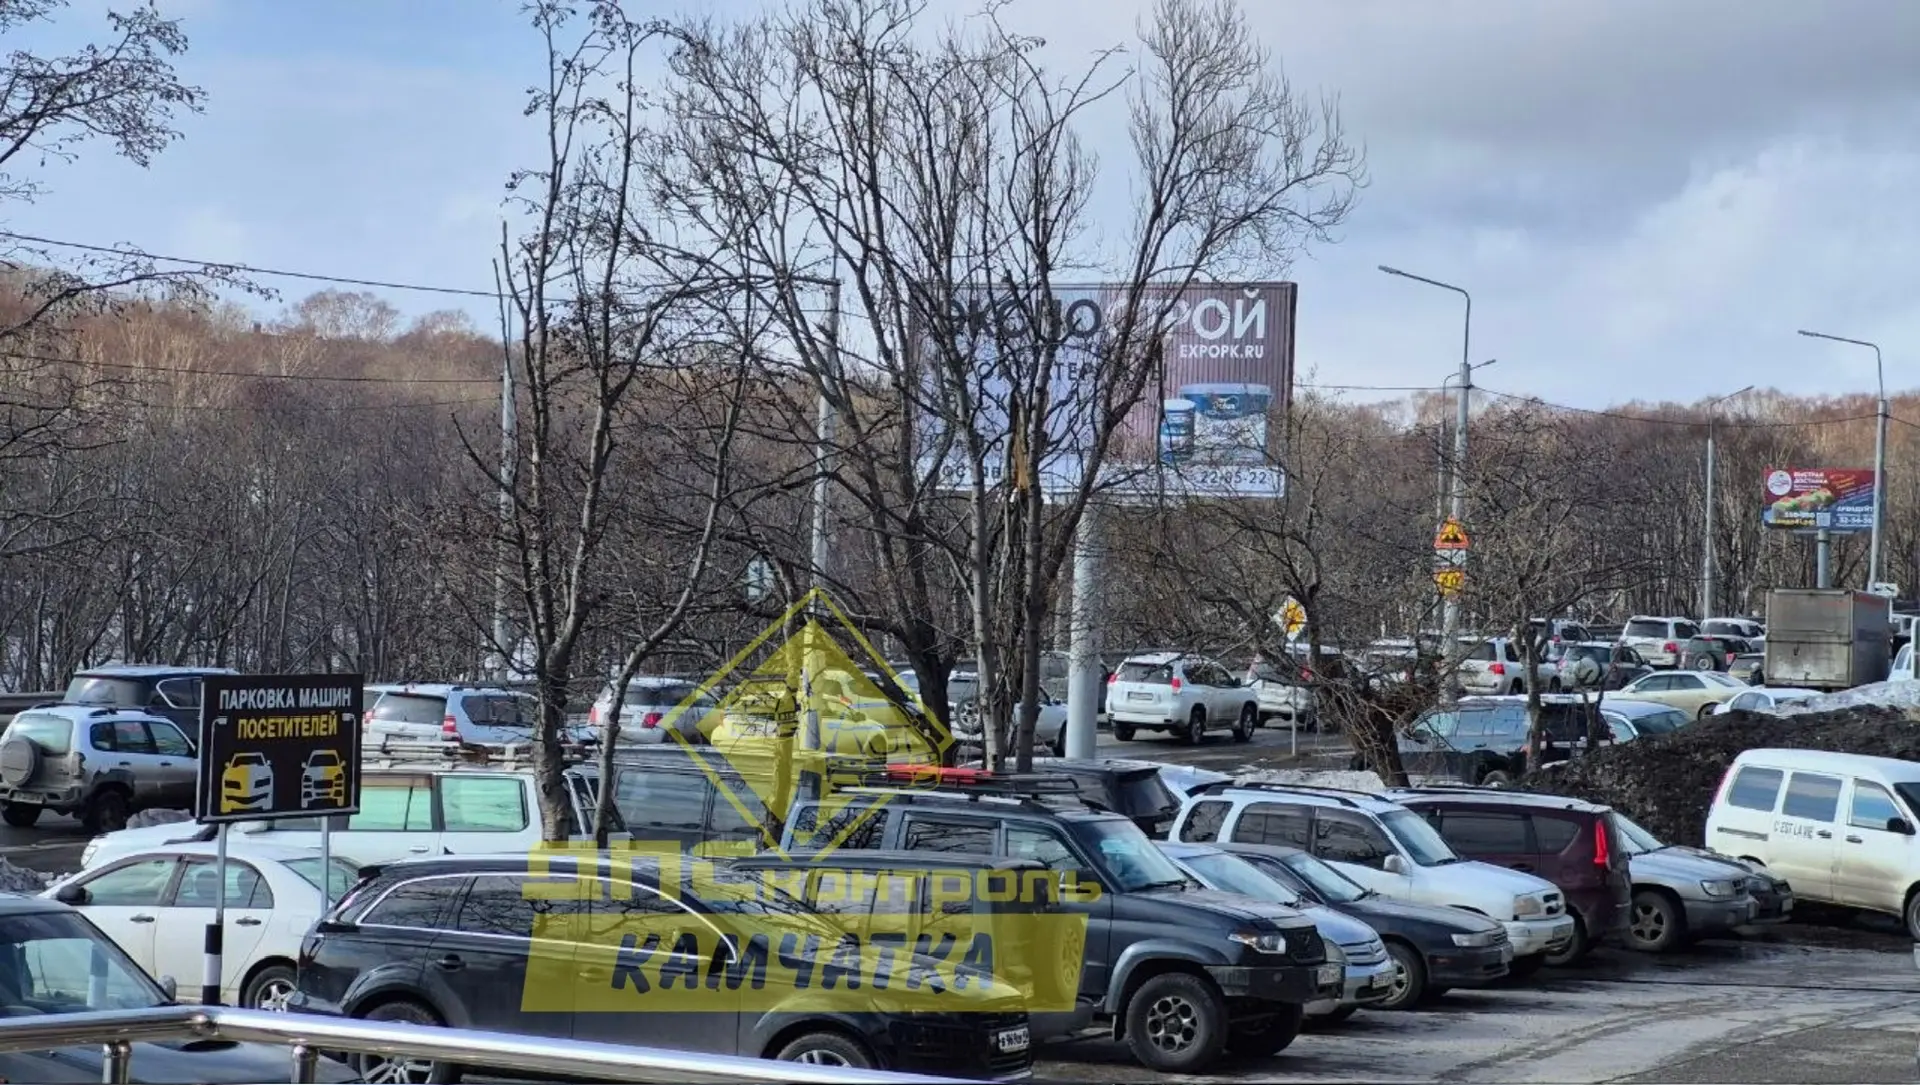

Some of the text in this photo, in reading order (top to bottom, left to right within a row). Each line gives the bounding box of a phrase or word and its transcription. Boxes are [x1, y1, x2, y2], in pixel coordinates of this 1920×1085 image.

[1180, 344, 1264, 359] EXPOPK.RU
[219, 687, 352, 710] ПАРКОВКА МАШИН
[237, 710, 338, 739] ПОСЕТИТЕЛЕЙ
